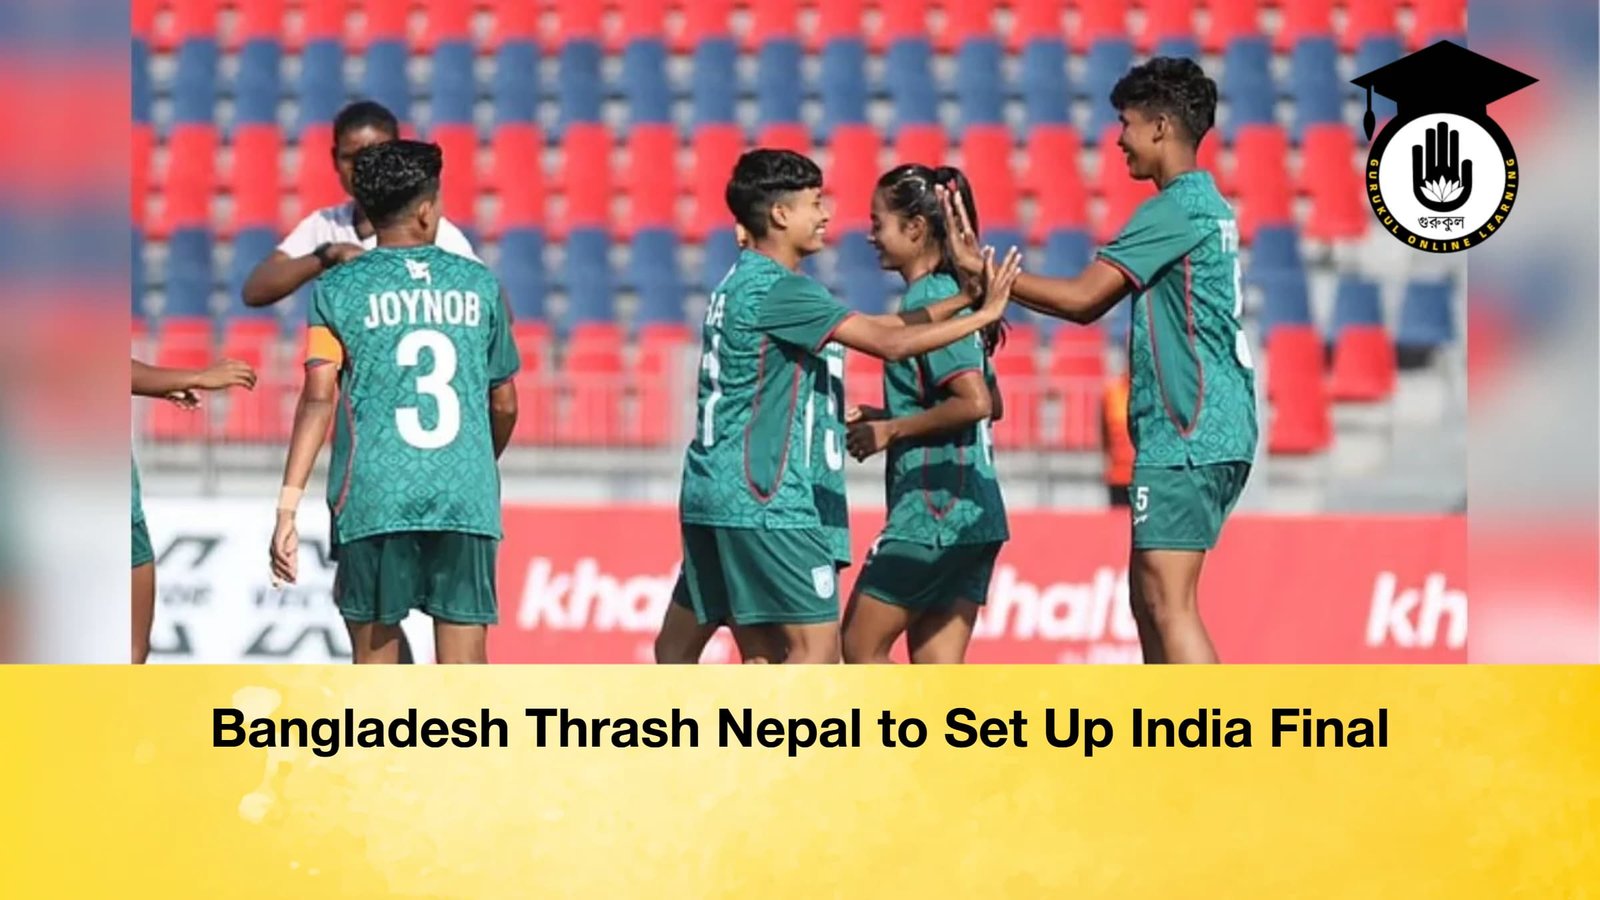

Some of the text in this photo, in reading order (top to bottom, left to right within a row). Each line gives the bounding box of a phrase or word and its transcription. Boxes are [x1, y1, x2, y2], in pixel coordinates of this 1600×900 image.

[364, 290, 480, 329] JOYNOB
[395, 329, 461, 449] 3
[1136, 486, 1150, 511] 5
[516, 556, 683, 631] kha
[1364, 571, 1467, 649] kh
